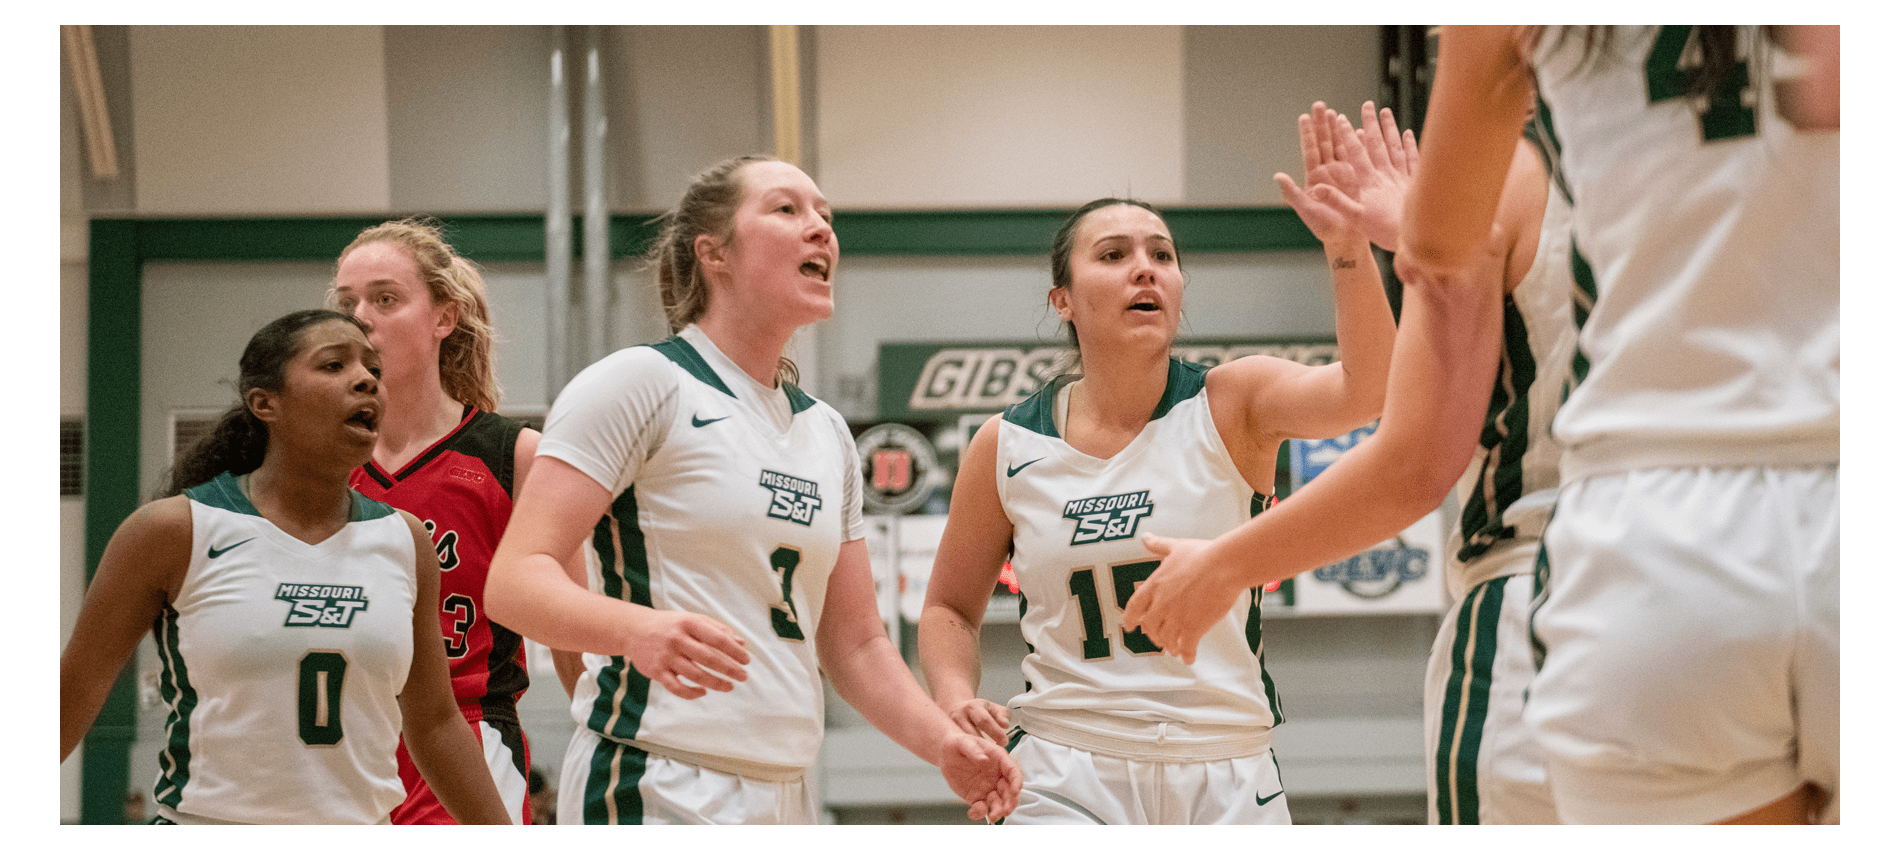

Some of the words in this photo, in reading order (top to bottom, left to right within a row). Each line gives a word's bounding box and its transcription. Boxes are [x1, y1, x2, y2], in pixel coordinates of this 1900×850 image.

[912, 350, 1060, 407] GIBS
[761, 471, 817, 496] MISSOURI
[770, 487, 820, 523] S&T
[1064, 492, 1146, 516] MISSOURI
[1074, 506, 1150, 543] S&T
[277, 584, 361, 600] MISSOURI
[769, 543, 805, 642] 3
[1065, 556, 1167, 663] 15
[288, 599, 365, 627] S&T
[297, 649, 348, 748] 0
